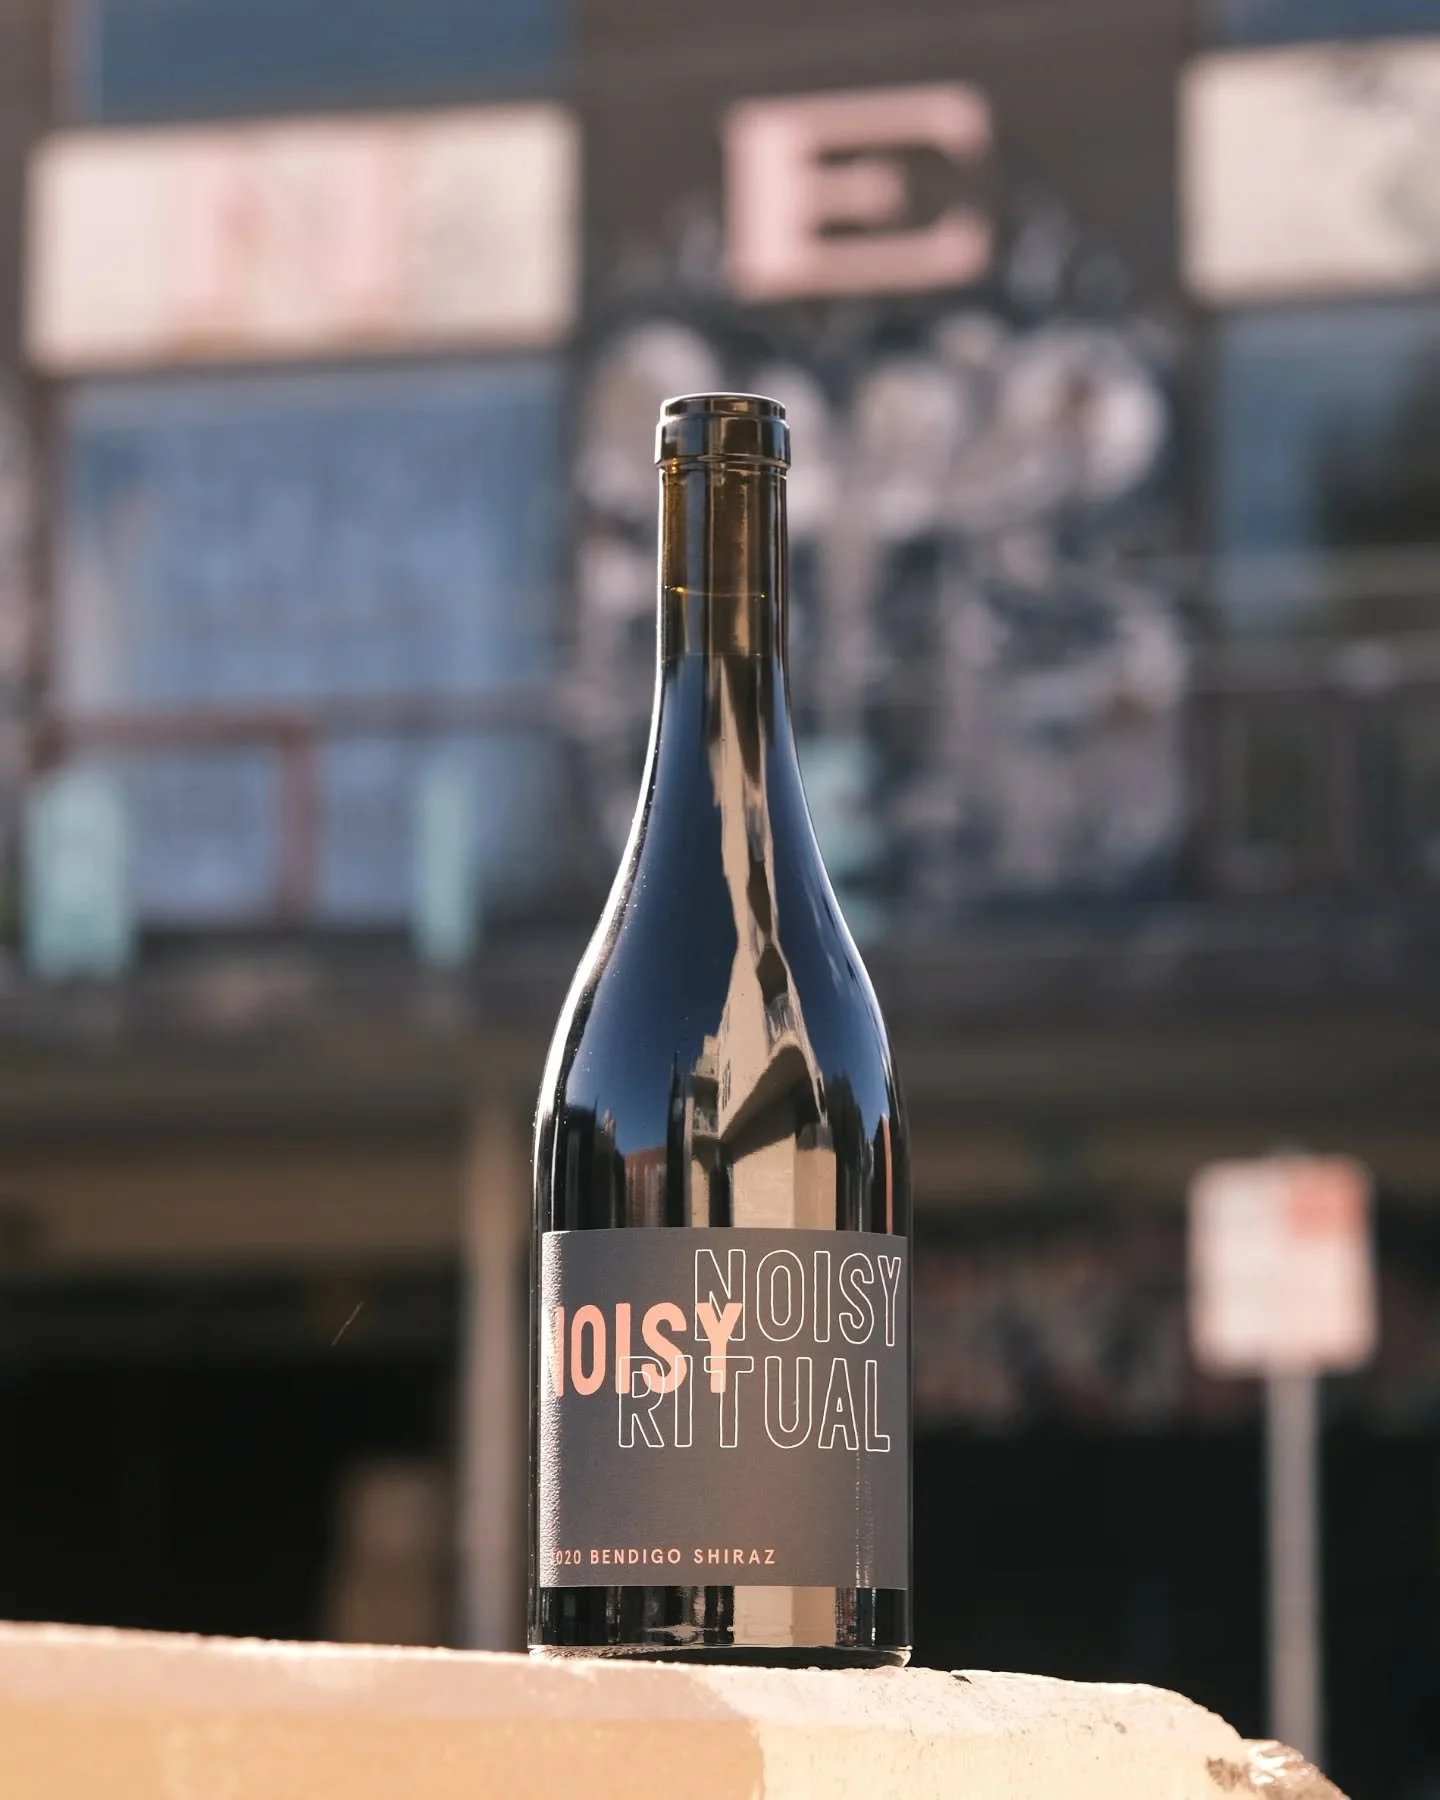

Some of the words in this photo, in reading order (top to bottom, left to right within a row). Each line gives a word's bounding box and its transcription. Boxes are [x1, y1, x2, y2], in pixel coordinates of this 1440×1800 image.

[724, 84, 991, 301] E
[694, 1248, 902, 1347] NOISY
[617, 1354, 891, 1453] RITUAL
[552, 1548, 582, 1566] 020
[589, 1547, 682, 1565] BENDIGO
[692, 1547, 776, 1565] SHIRAZ
